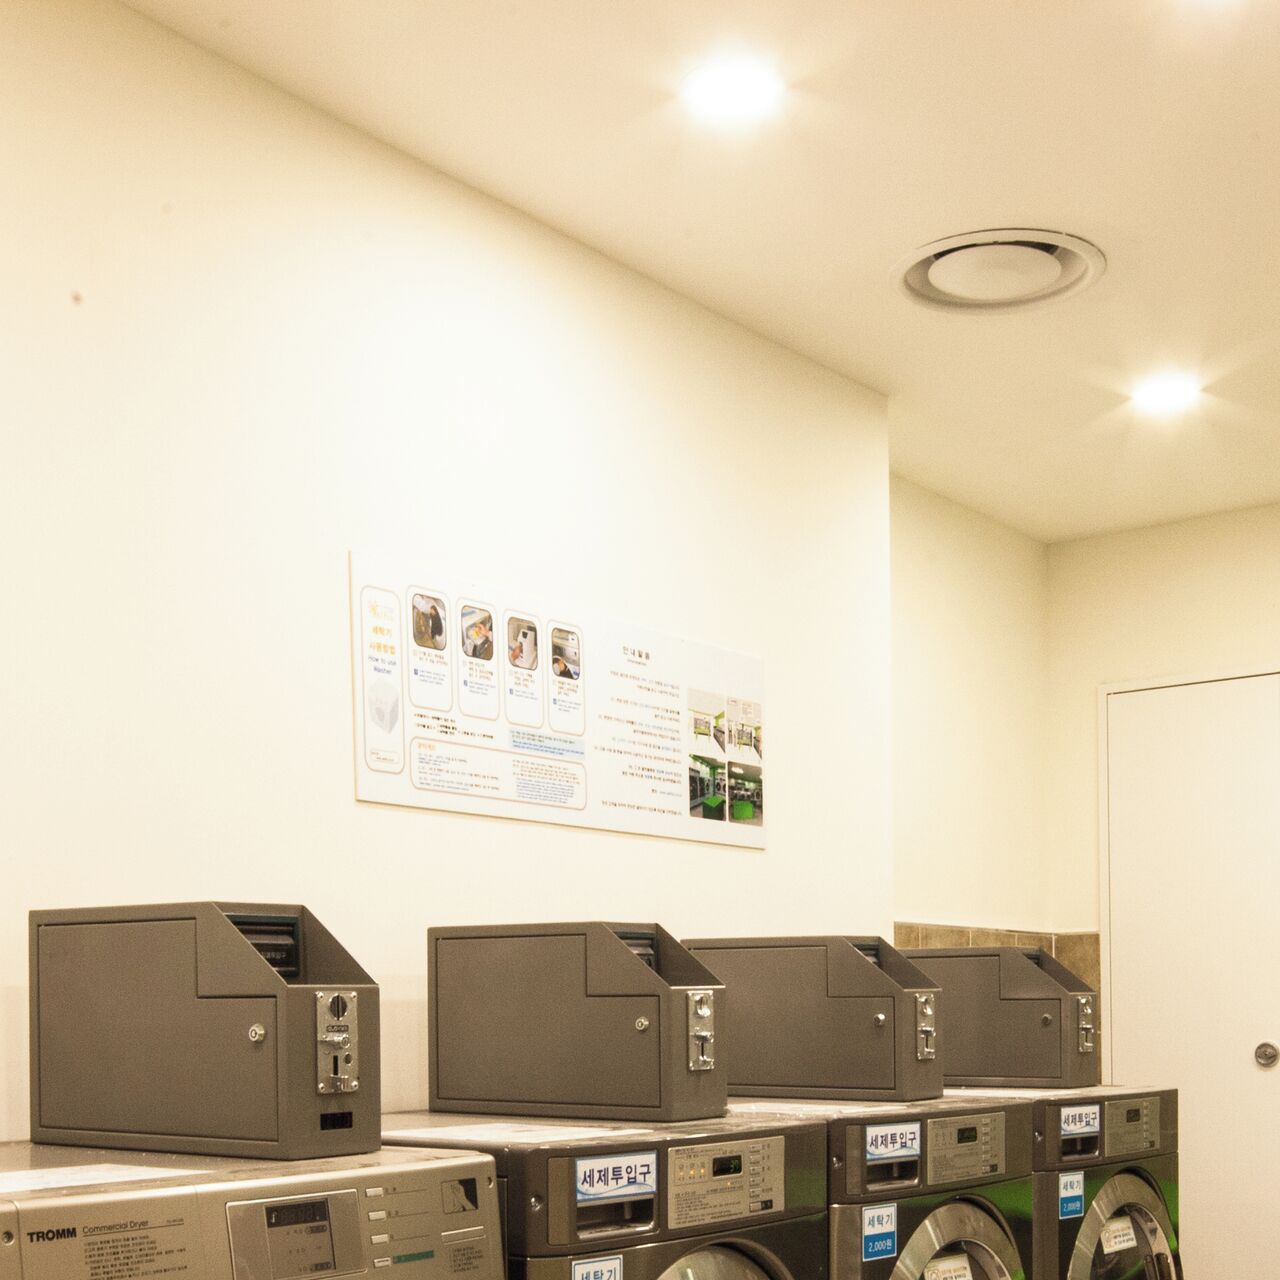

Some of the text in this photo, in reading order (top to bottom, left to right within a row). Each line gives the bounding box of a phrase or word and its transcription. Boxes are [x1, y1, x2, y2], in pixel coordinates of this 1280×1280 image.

[1063, 1112, 1098, 1127] 세제투입구
[870, 1132, 916, 1150] 세제투입구
[581, 1162, 653, 1189] 세제투입구
[1062, 1180, 1082, 1192] 세탁기
[868, 1212, 893, 1228] 세탁기
[27, 1220, 149, 1242] TROMM Commercial Dryer
[868, 1238, 892, 1252] 2,000원
